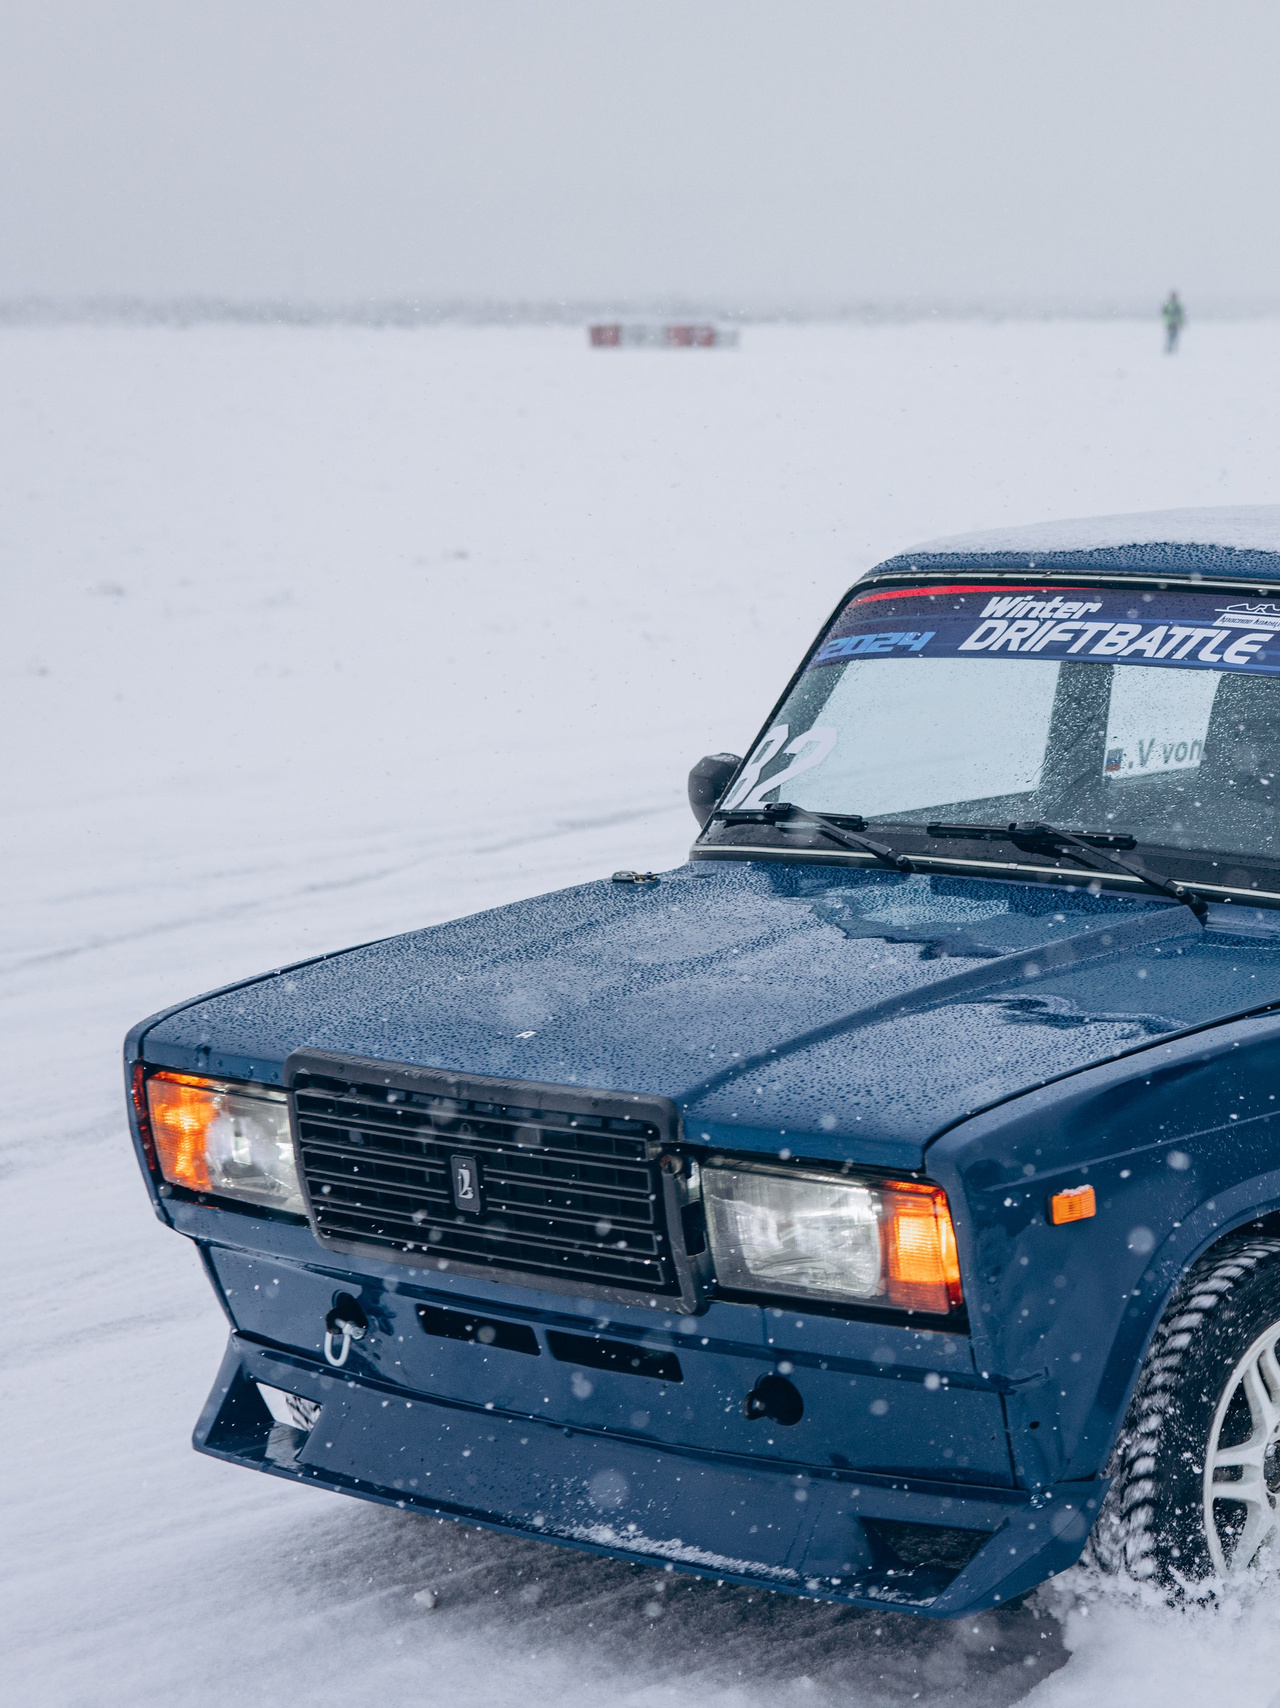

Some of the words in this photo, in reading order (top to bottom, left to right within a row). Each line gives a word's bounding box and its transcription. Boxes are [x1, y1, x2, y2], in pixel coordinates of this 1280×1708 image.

[979, 595, 1102, 619] Winter
[815, 631, 937, 661] 2024
[957, 619, 1274, 665] DRIFTBATTLE
